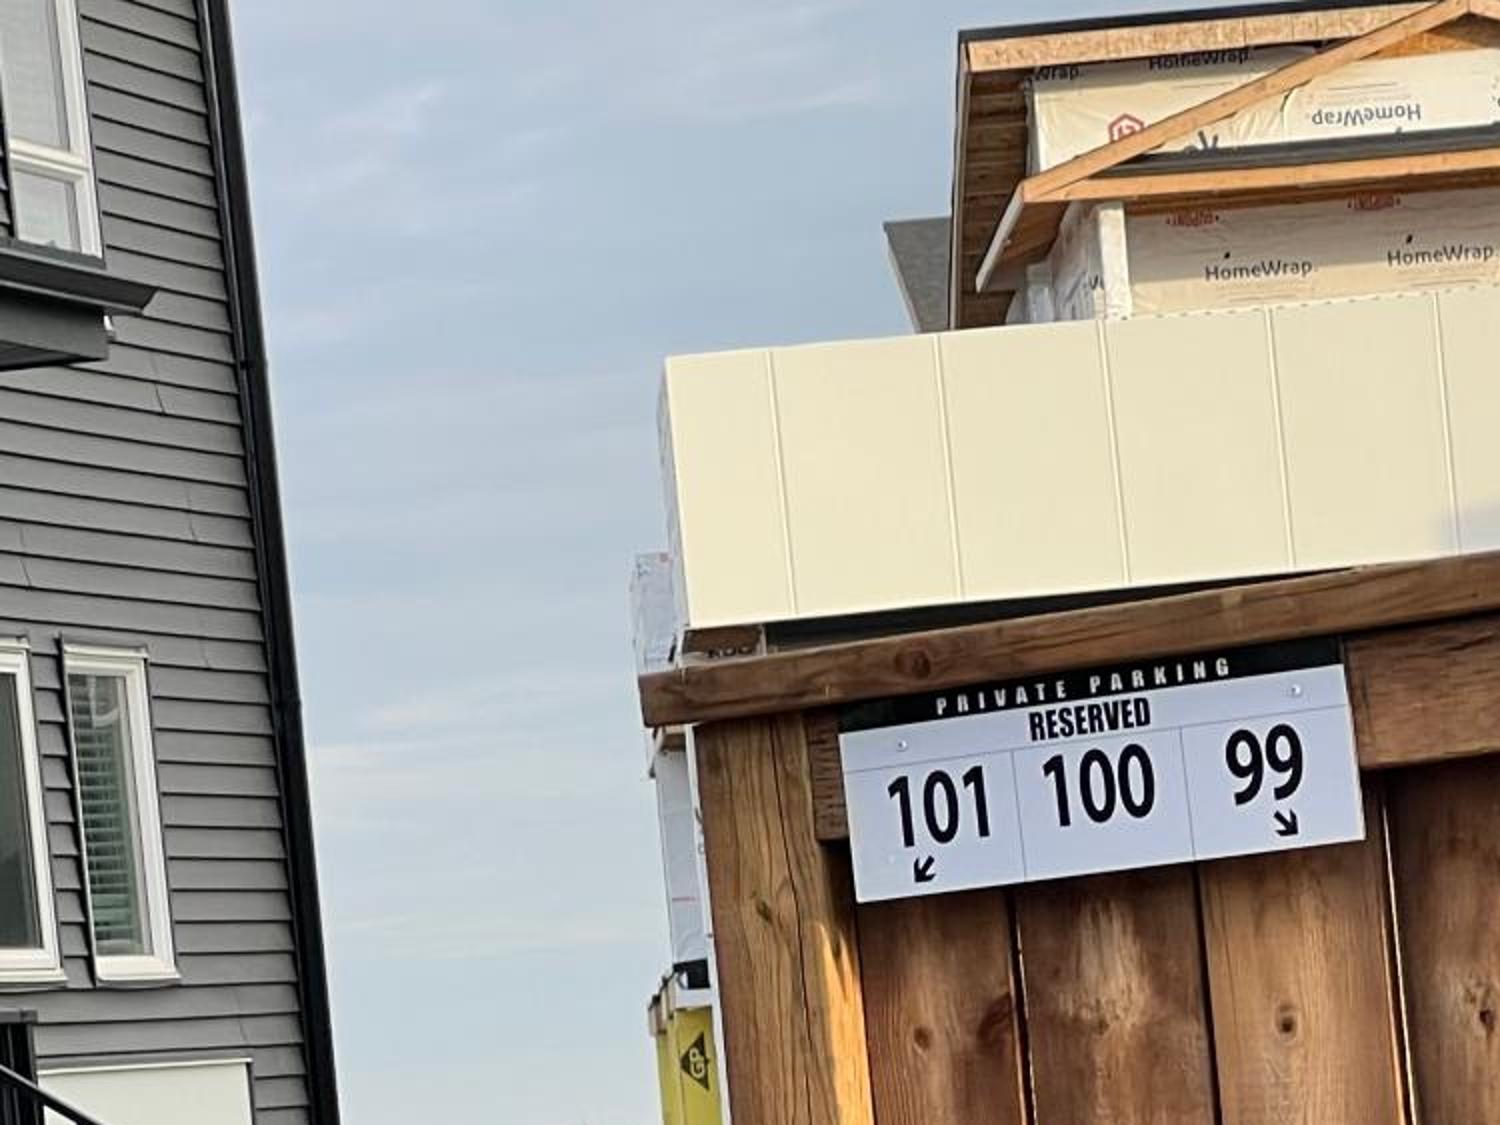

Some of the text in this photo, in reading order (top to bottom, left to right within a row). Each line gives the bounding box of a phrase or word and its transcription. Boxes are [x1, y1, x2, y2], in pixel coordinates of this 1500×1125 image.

[1311, 103, 1421, 128] HomeWrap
[1204, 259, 1313, 282] HomeWrap
[1386, 243, 1495, 267] HomeWrap
[936, 657, 1230, 715] PRIVATE PARKING
[1029, 697, 1151, 742] RESERVED
[1042, 743, 1156, 827] 100
[1225, 722, 1303, 805] 99
[888, 765, 990, 848] 101
[689, 1047, 706, 1079] GP
